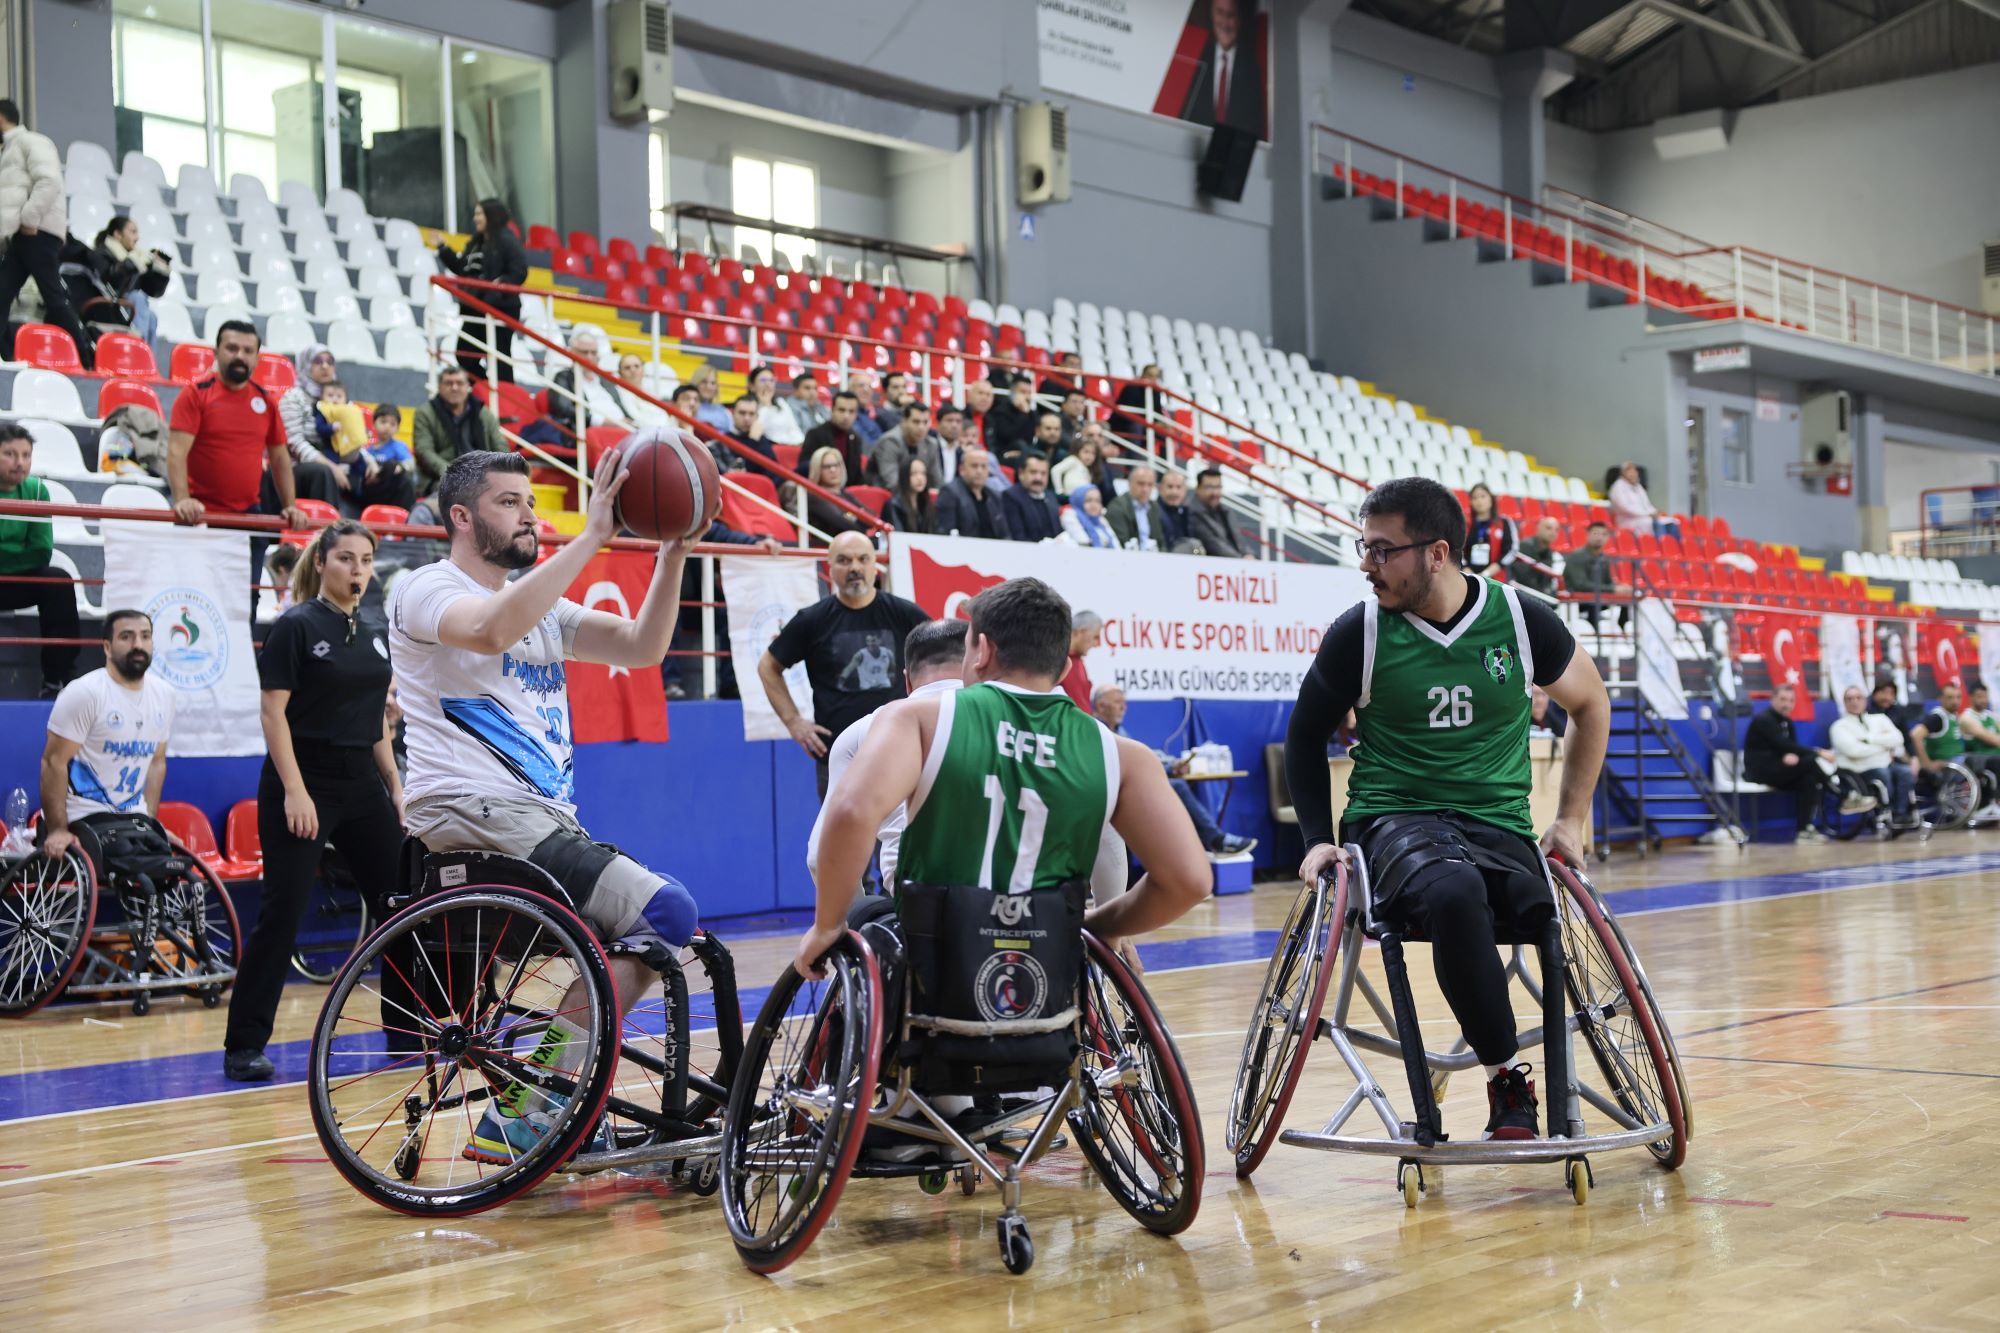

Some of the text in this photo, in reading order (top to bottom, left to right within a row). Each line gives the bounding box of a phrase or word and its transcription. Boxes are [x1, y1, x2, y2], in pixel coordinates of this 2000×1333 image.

[1197, 570, 1278, 604] DENİZLİ
[1098, 613, 1324, 657] ÇLİK VE SPOR İL MÜD
[1115, 668, 1174, 692] HASAN
[1179, 666, 1249, 692] GÜNGÖR
[1253, 671, 1293, 692] SPOR
[1427, 685, 1473, 728] 26
[996, 720, 1057, 768] EFE
[113, 766, 141, 792] 14
[977, 774, 1049, 895] 11
[979, 927, 1048, 938] INTERCEPTOR
